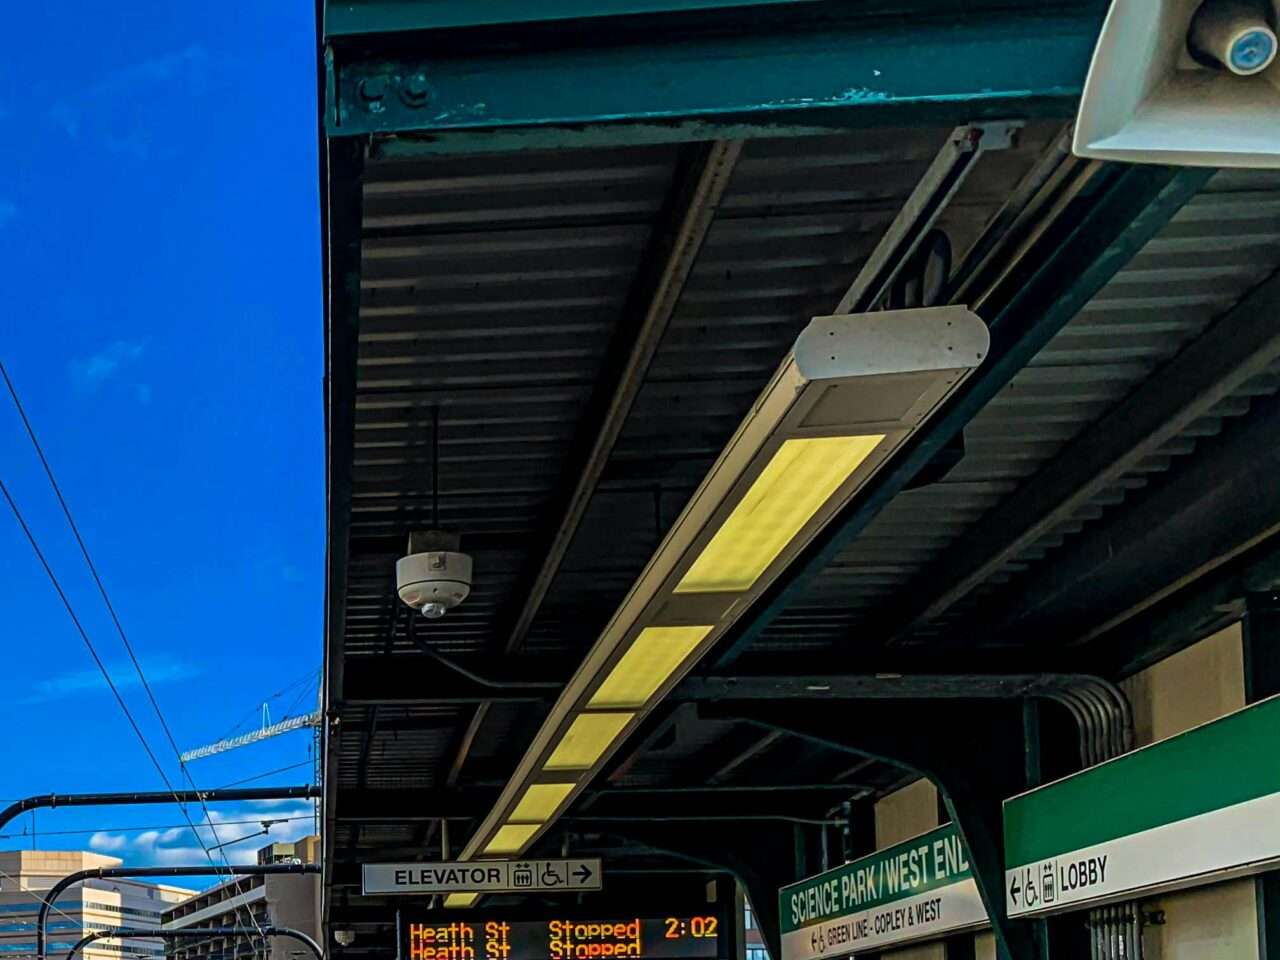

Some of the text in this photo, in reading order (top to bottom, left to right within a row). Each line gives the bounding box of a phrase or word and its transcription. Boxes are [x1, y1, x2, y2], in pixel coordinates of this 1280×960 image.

[394, 867, 502, 885] ELEVATOR
[791, 879, 840, 925] SCIENCE
[842, 864, 877, 909] PARK
[885, 845, 929, 895] WEST
[1061, 855, 1107, 892] LOBBY
[410, 917, 718, 942] Heath St Stopped 2:02
[827, 925, 851, 946] GREEN
[852, 918, 868, 940] LINE
[874, 908, 906, 935] COPLEY
[915, 898, 942, 923] WEST
[485, 940, 511, 960] St
[549, 939, 641, 960] Stopped
